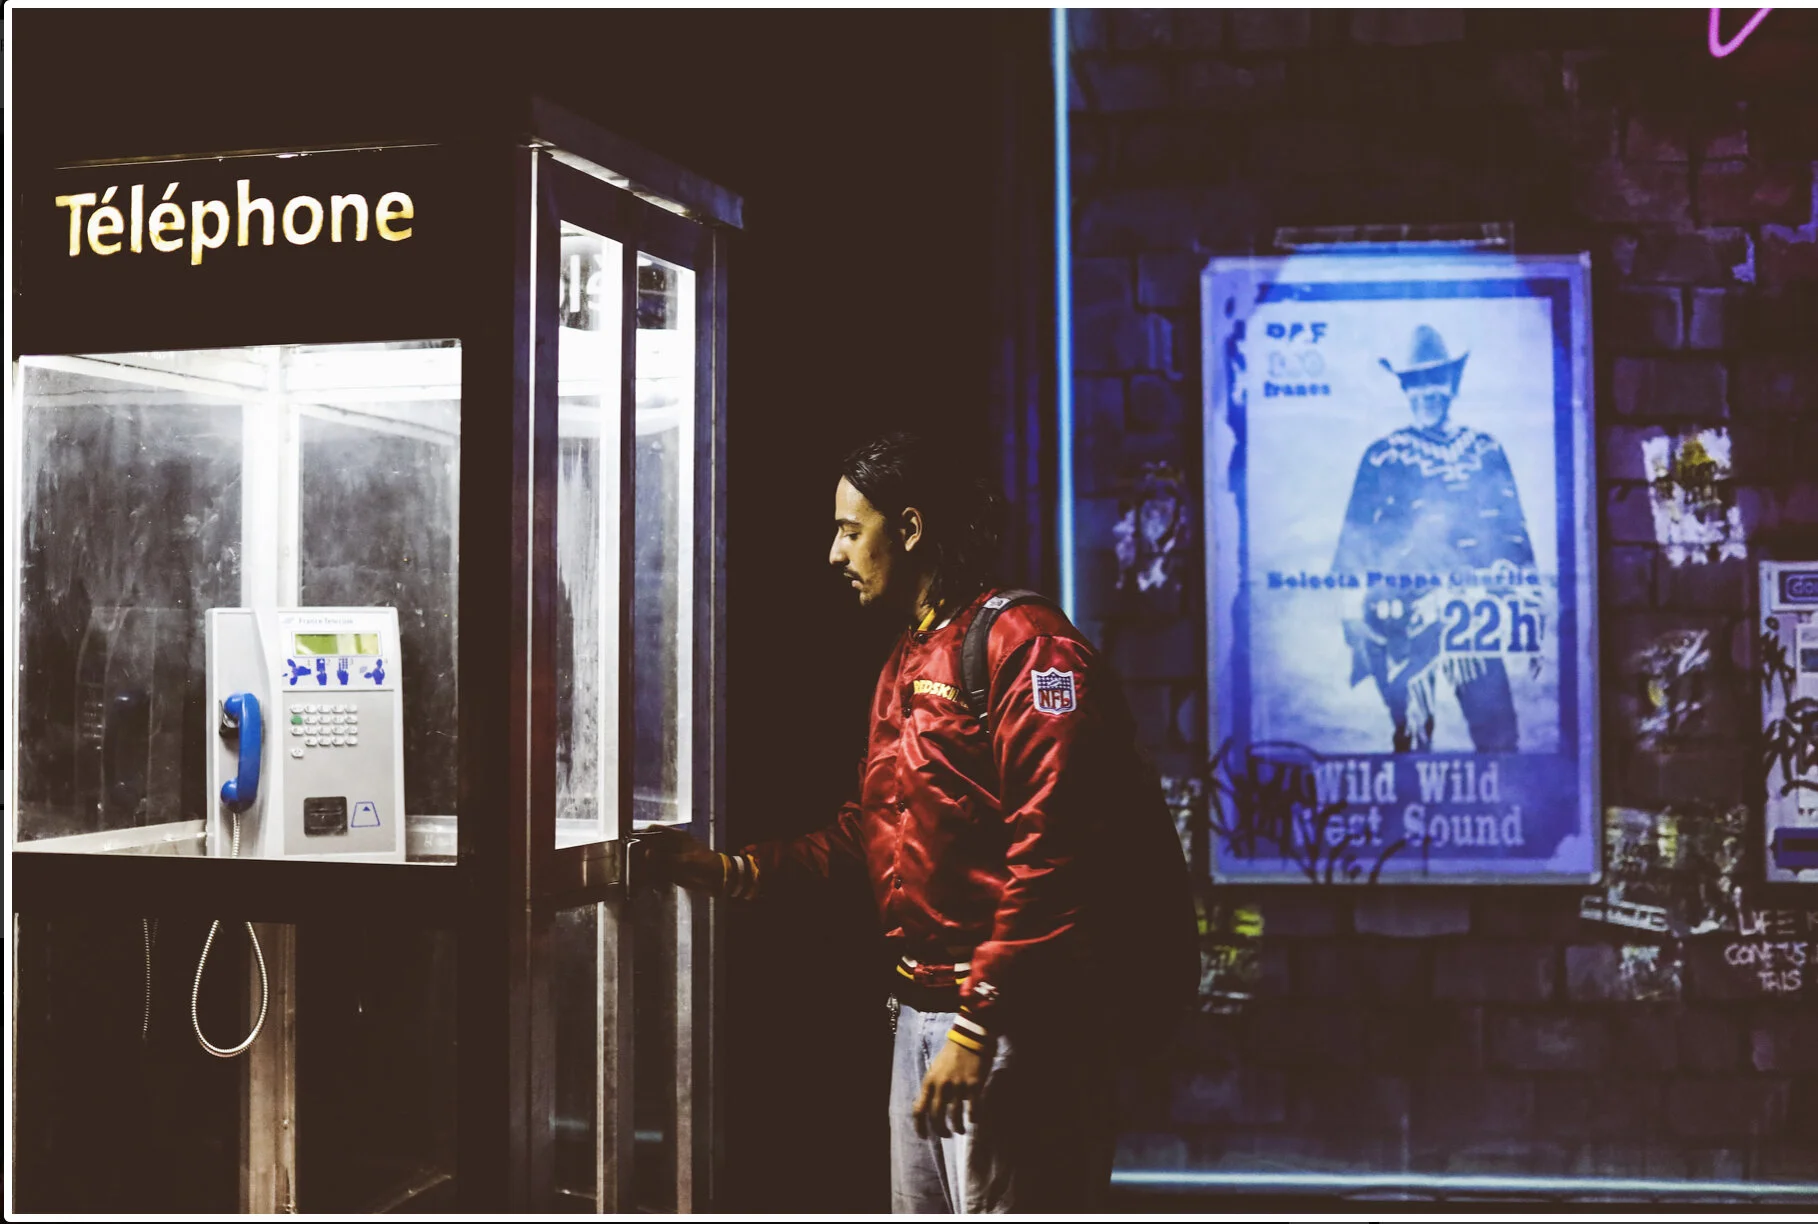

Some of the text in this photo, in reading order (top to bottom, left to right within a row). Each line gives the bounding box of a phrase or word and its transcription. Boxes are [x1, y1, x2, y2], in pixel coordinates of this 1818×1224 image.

[55, 179, 415, 266] Téléphone
[1444, 599, 1541, 652] 22h
[1039, 689, 1071, 709] NFL
[1313, 759, 1501, 804] Wild Wild
[1403, 804, 1525, 847] Sound
